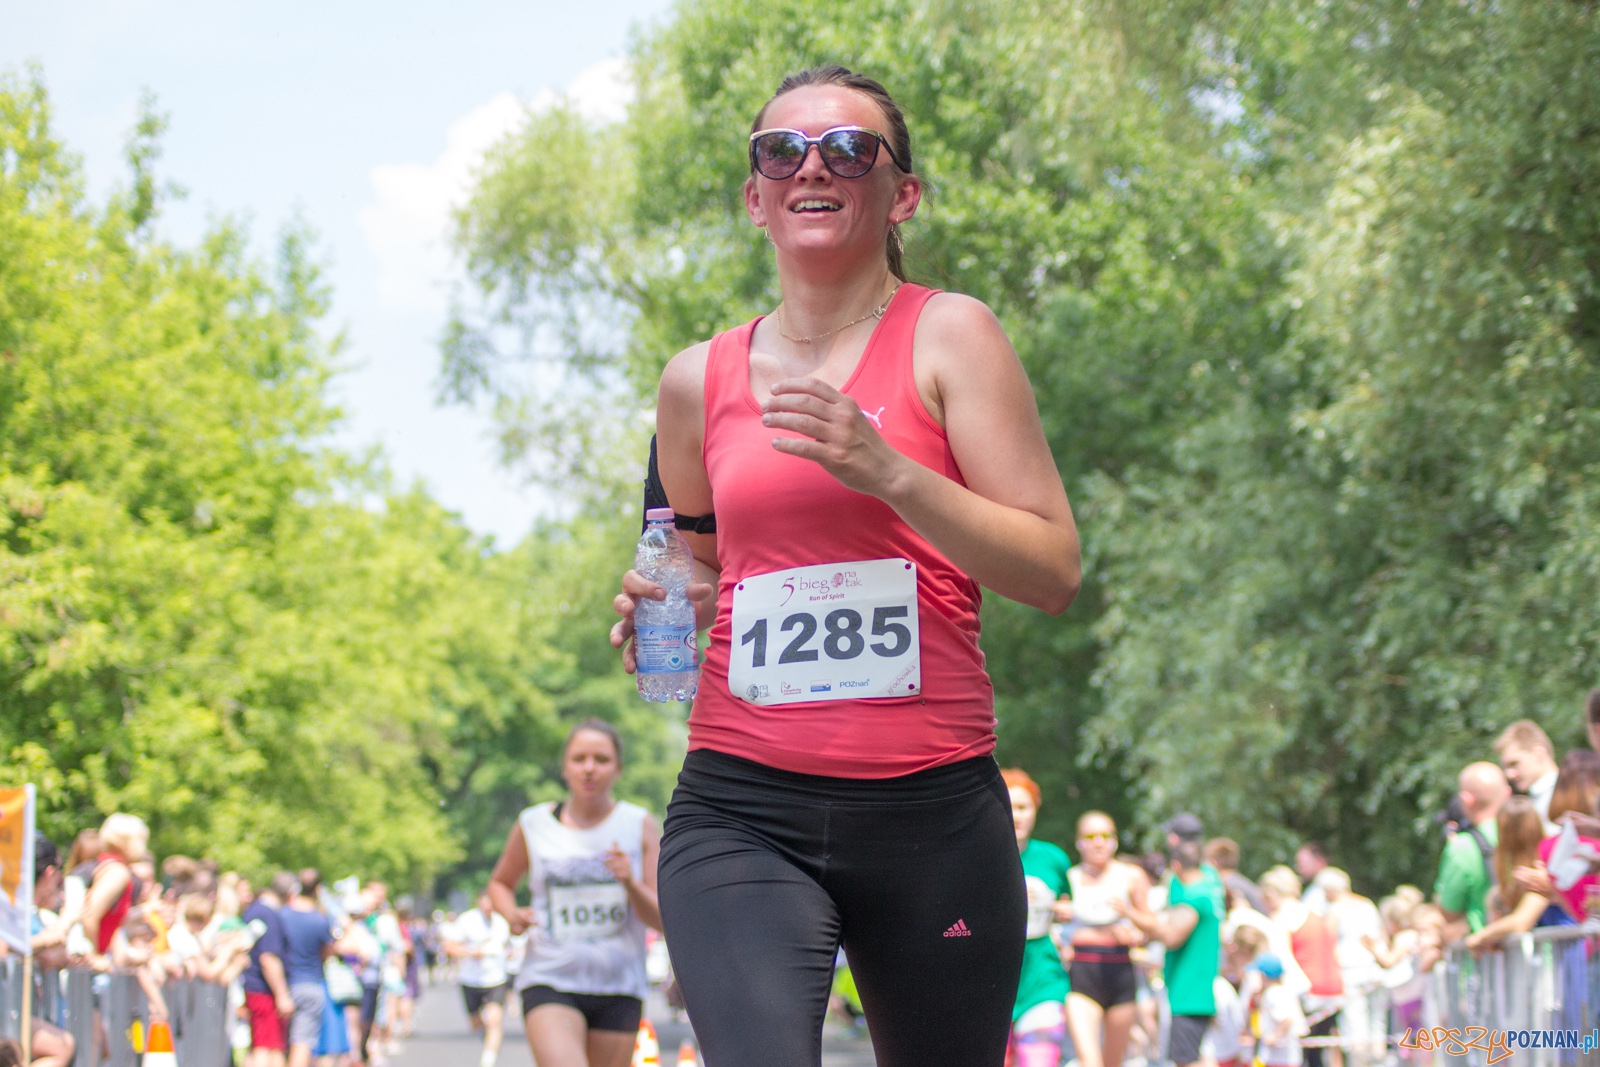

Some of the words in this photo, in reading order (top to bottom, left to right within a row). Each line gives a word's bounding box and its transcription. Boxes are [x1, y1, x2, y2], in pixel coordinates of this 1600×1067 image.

[845, 578, 862, 587] tak
[780, 576, 795, 607] 5
[799, 577, 830, 594] bieg
[829, 593, 845, 601] Spirit
[741, 605, 912, 668] 1285
[559, 903, 624, 926] 1056
[943, 929, 972, 937] adidas
